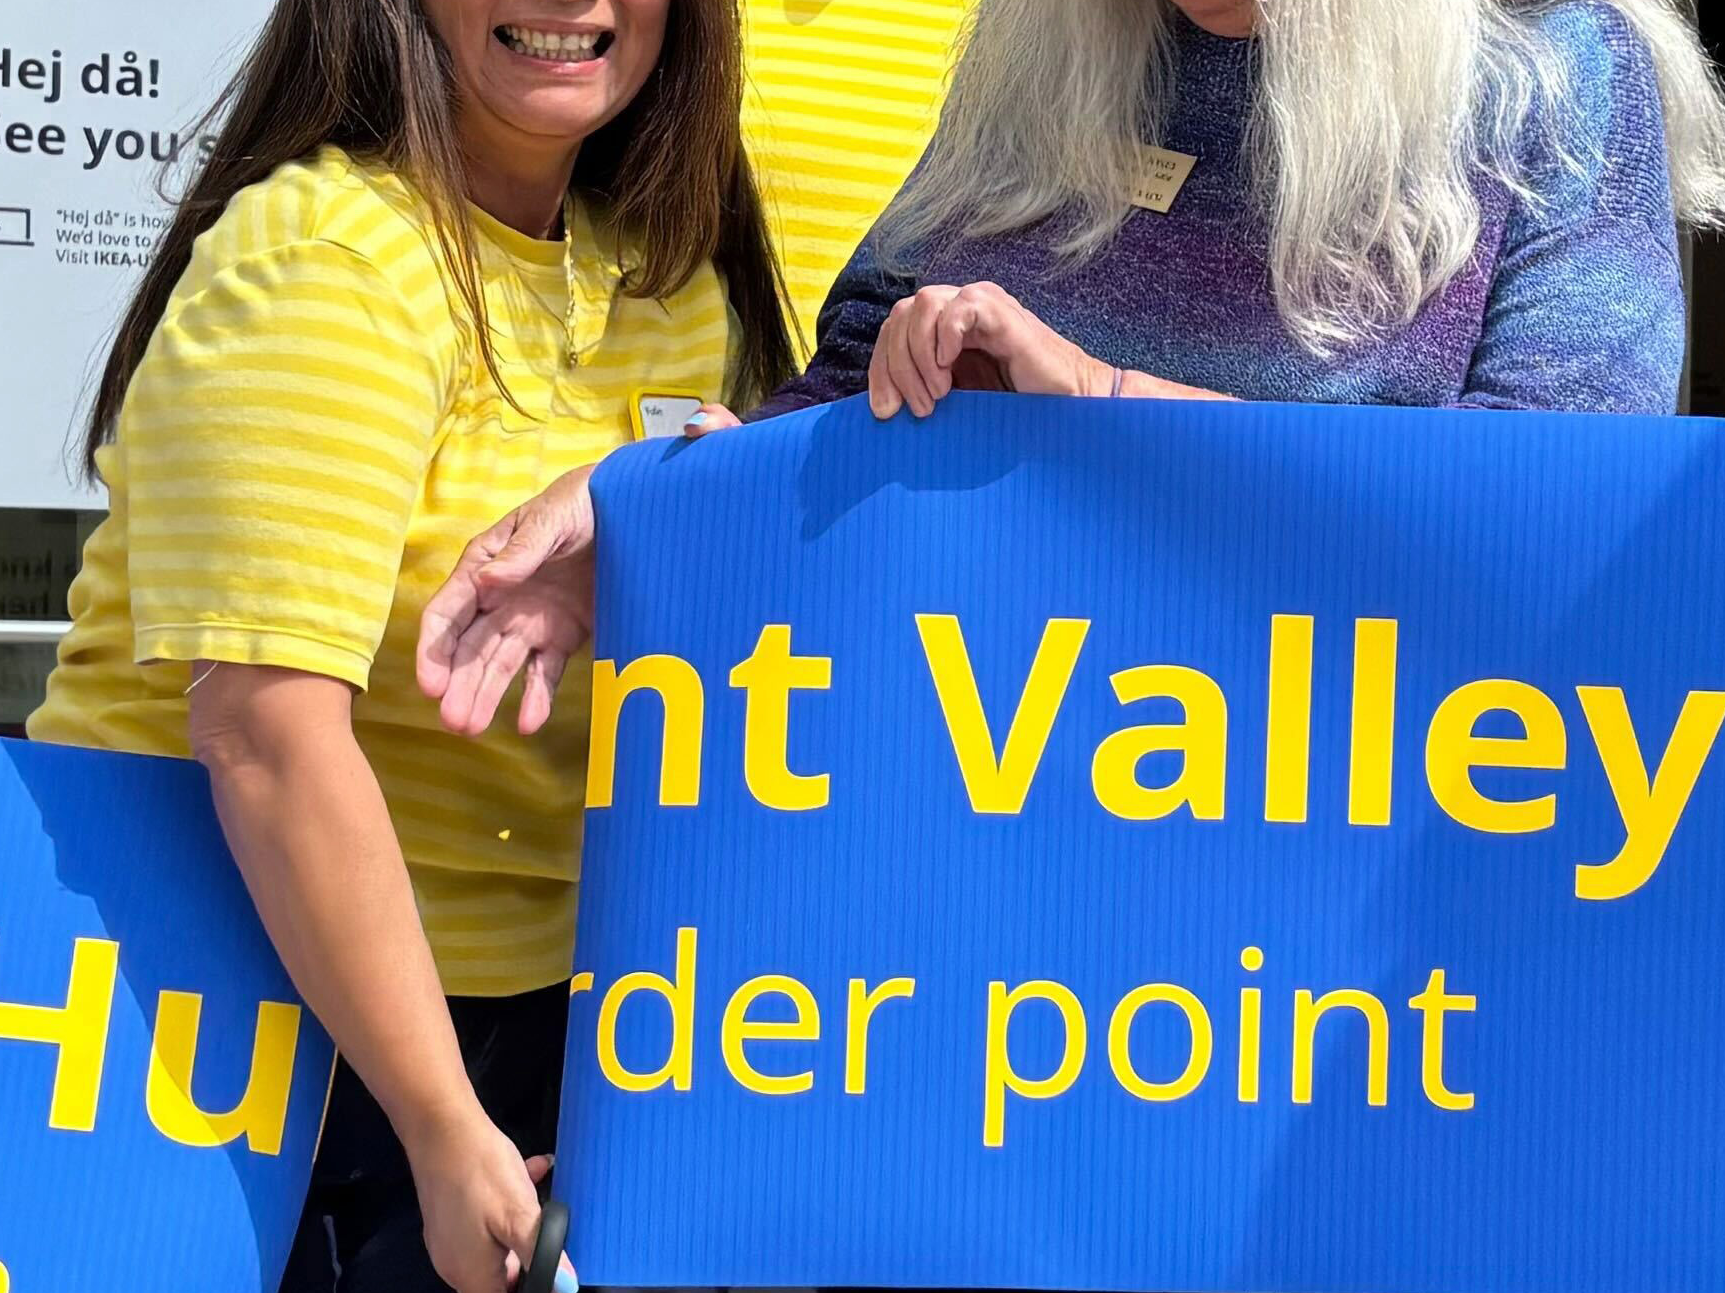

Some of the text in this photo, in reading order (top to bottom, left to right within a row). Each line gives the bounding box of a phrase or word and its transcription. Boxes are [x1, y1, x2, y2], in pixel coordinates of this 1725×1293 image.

[81, 50, 160, 99] då!
[82, 127, 179, 171] you
[98, 230, 130, 246] love
[135, 234, 151, 248] to
[124, 212, 136, 227] is
[56, 249, 89, 264] Visit
[585, 625, 832, 810] nt
[983, 947, 1477, 1147] point
